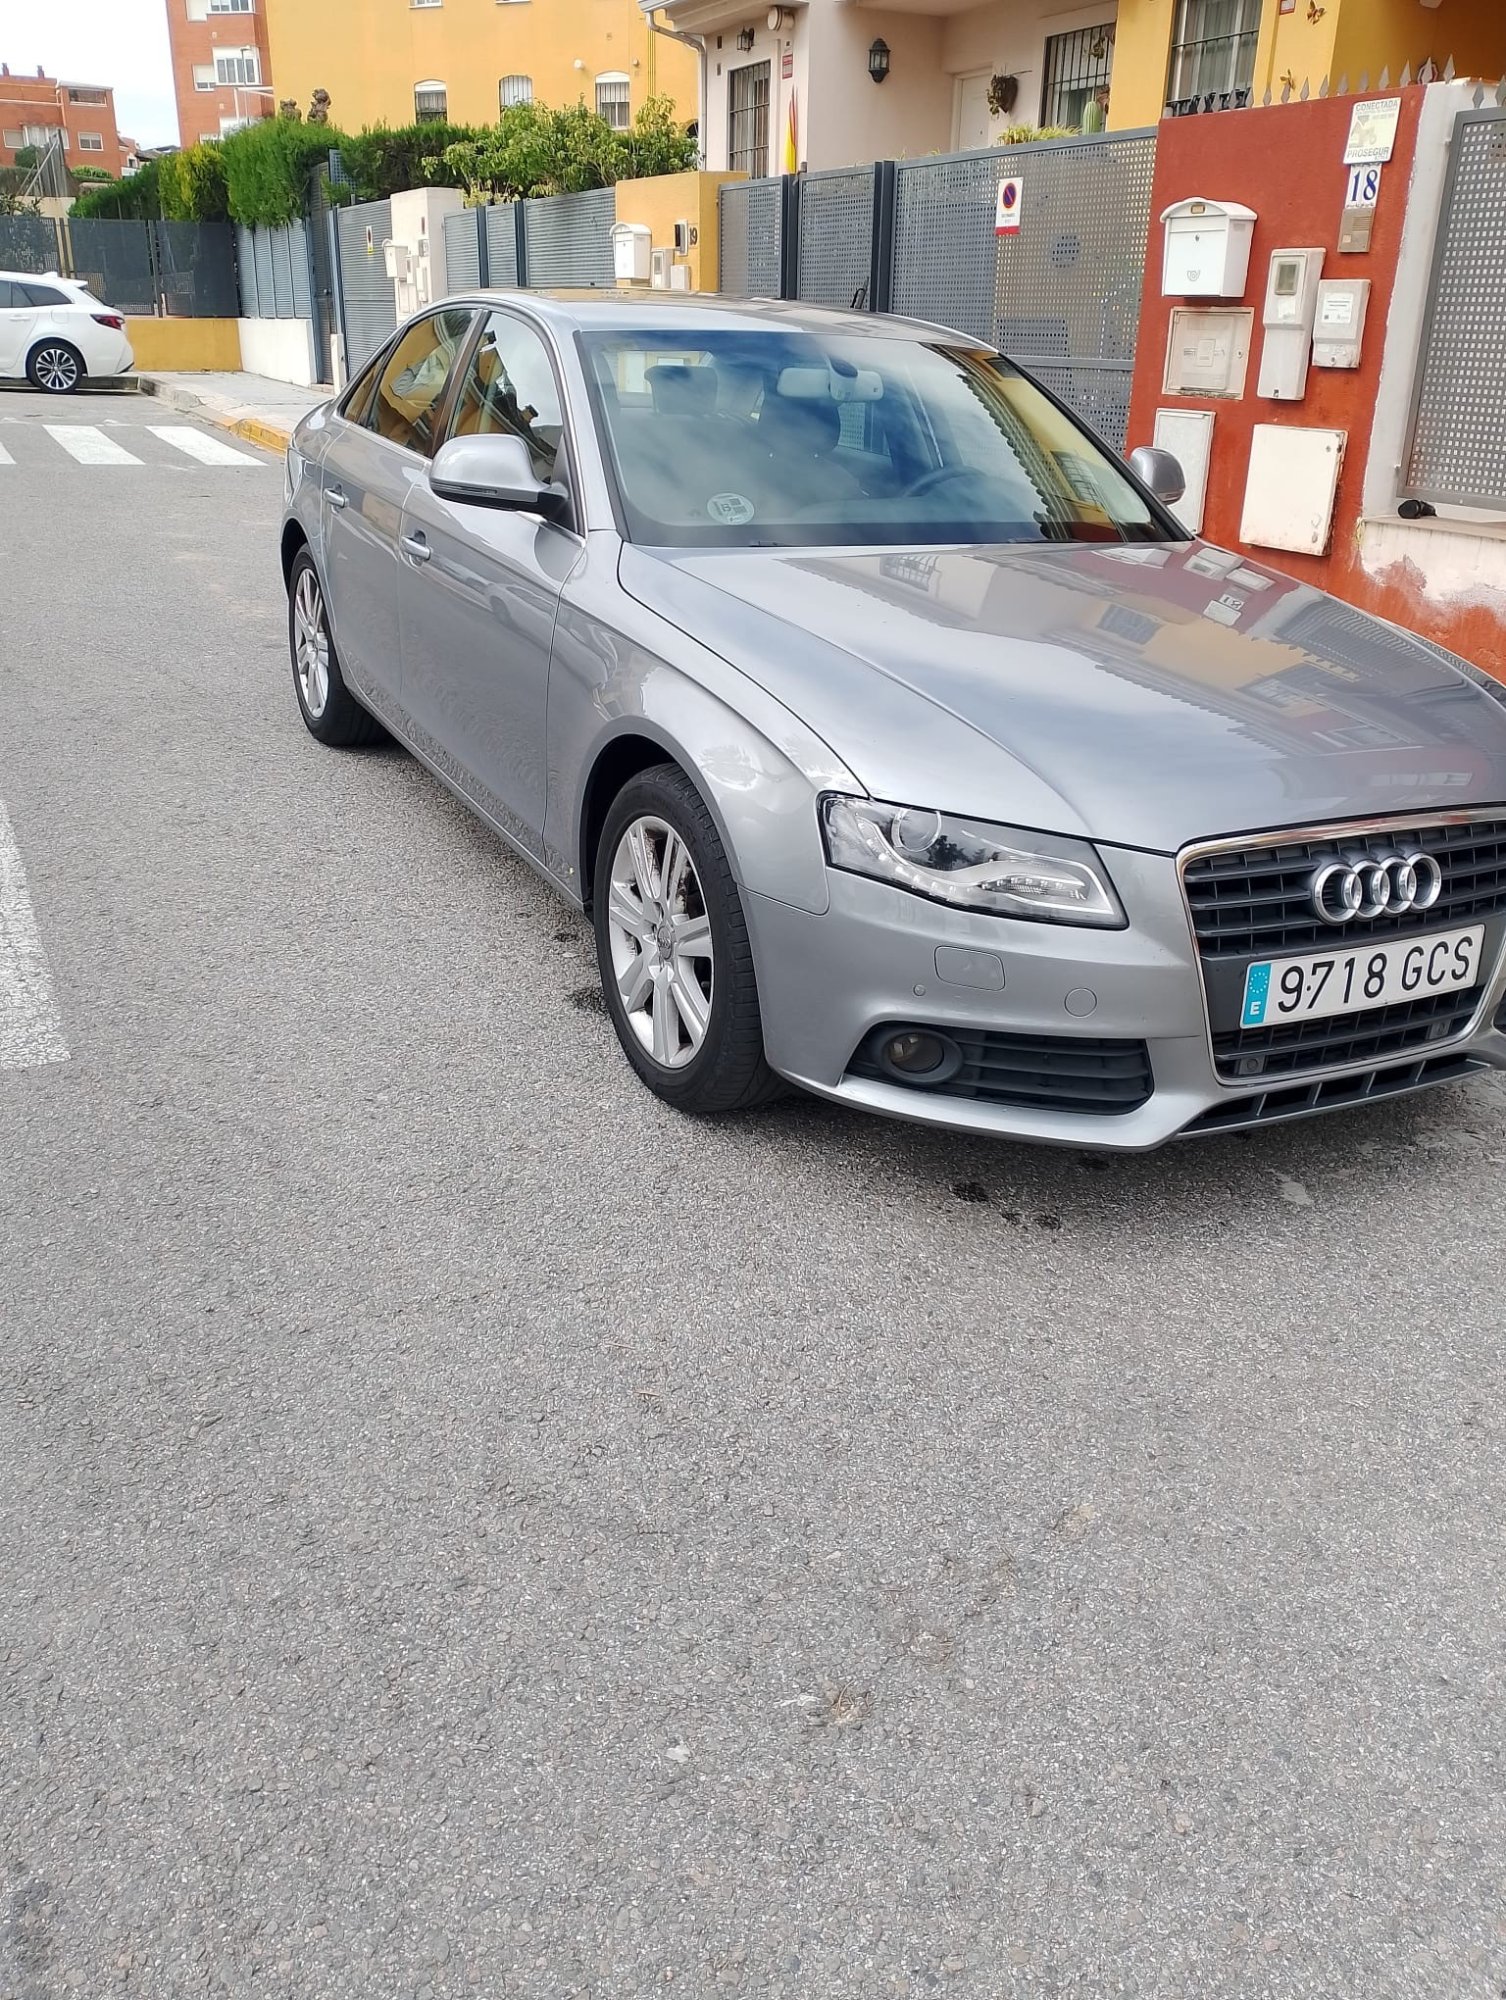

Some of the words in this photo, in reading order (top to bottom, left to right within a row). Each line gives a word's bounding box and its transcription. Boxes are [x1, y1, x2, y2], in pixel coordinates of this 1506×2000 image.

[1356, 100, 1398, 111] CONECTADA
[1347, 147, 1390, 158] PROSEGUR
[1351, 169, 1378, 201] 18
[1250, 1001, 1261, 1014] E
[1278, 952, 1388, 1013] 9718
[1401, 935, 1473, 991] GCS
